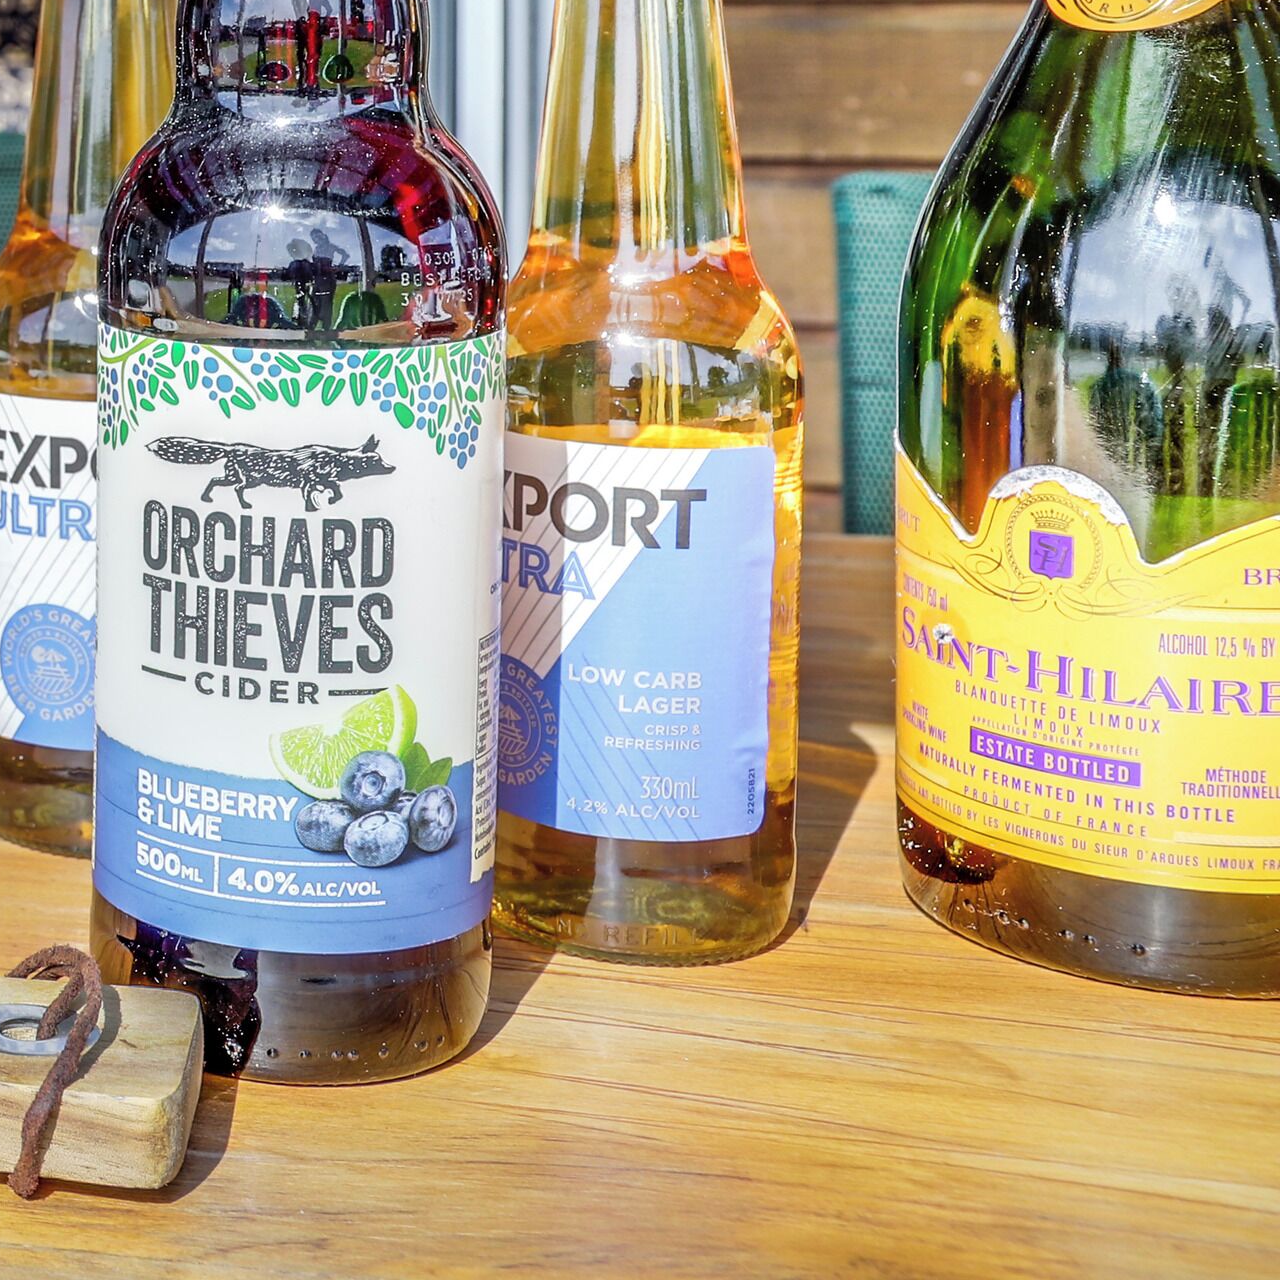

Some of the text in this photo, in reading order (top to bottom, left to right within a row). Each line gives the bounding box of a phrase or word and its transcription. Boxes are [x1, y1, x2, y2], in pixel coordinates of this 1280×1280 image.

[503, 470, 707, 549] PORT
[143, 499, 395, 589] ORCHARD
[4, 609, 44, 668] WORLD'S
[142, 572, 394, 674] THIEVES
[902, 605, 1280, 716] SAINT-HILAIRE
[1158, 632, 1276, 659] ALCOHOL 12,5 % BY
[194, 671, 320, 705] CIDER
[568, 663, 702, 690] LOW CARB
[506, 663, 558, 749] GREATEST
[618, 694, 701, 714] LAGER
[955, 679, 1161, 734] BLANQUETTE DE LIMOUX
[604, 736, 701, 751] REFRESHING
[644, 724, 701, 736] CRISP &
[928, 725, 948, 744] WINE
[972, 715, 1027, 737] APPELLATION
[1089, 741, 1140, 757] PROTÉGÉE
[1014, 713, 1084, 738] LIMOUX
[498, 751, 553, 787] GARDEN
[976, 734, 1131, 783] ESTATE BOTTLED
[1205, 766, 1268, 784] MÉTHODE
[137, 767, 299, 822] BLUEBERRY
[640, 775, 700, 800] 330mL
[919, 741, 1236, 823] NATURALLY FERMENTED IN THIS BOTTLE
[566, 796, 700, 820] 4.2% ALC/VOL
[964, 785, 1148, 838] PRODUCT OF FRANCE
[932, 792, 963, 816] BOTTLED
[967, 809, 978, 822] BY
[983, 815, 1000, 829] LES
[1005, 822, 1065, 846] VIGNERONS
[1072, 837, 1087, 851] DU
[1094, 842, 1129, 858] SIEUR
[1136, 849, 1200, 867] D'ARQUES
[1207, 857, 1255, 870] LIMOUX
[301, 881, 382, 898] ALC/VOL
